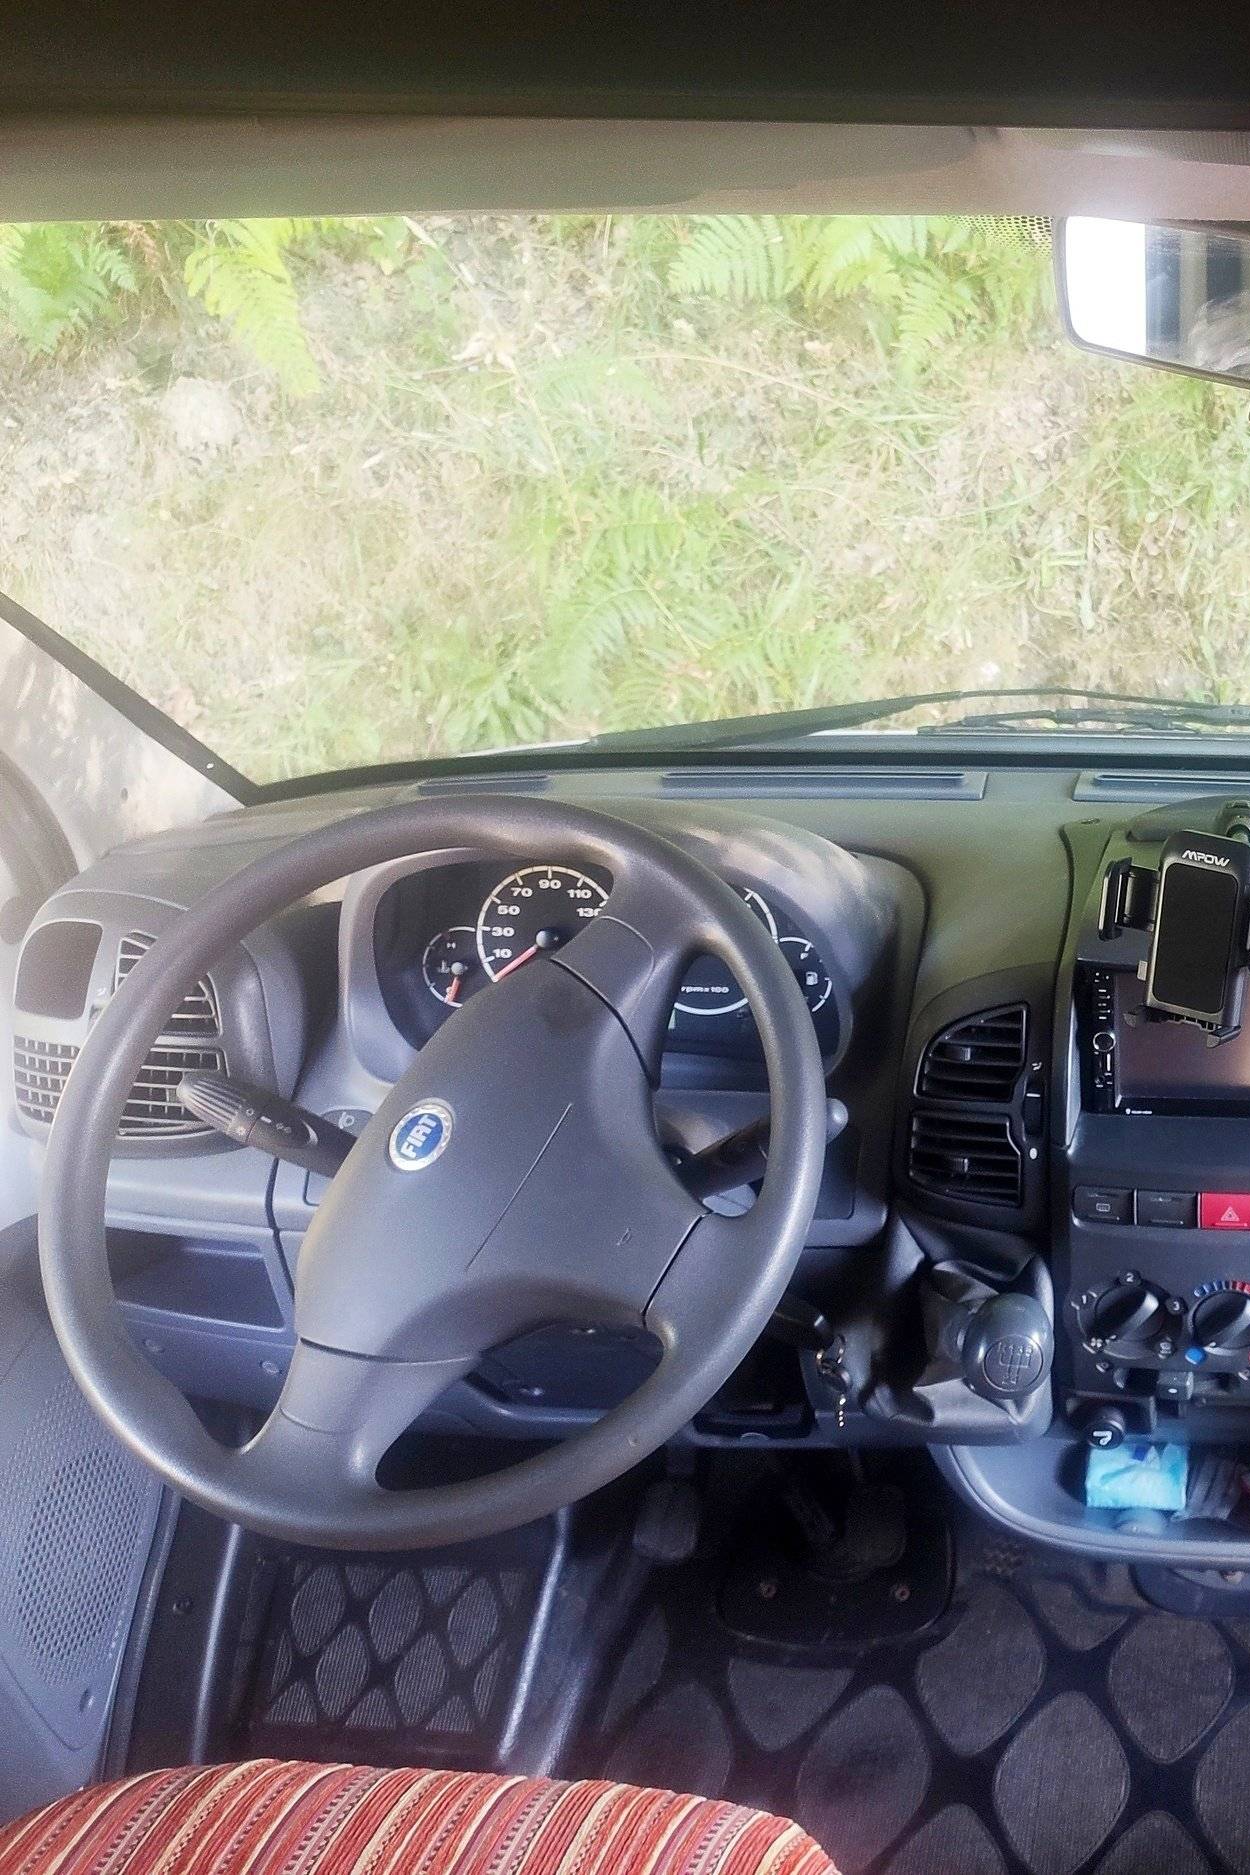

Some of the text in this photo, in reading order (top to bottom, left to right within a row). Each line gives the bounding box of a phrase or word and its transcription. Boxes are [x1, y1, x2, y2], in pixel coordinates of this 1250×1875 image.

[1182, 849, 1230, 867] MPOW
[538, 879, 562, 890] 90
[510, 887, 533, 898] 70
[567, 889, 592, 899] 110
[497, 905, 521, 916] 50
[491, 926, 515, 937] 30
[492, 948, 512, 959] 10
[400, 1114, 437, 1159] FIAT
[1126, 1272, 1134, 1283] 2
[1172, 1300, 1180, 1311] 3
